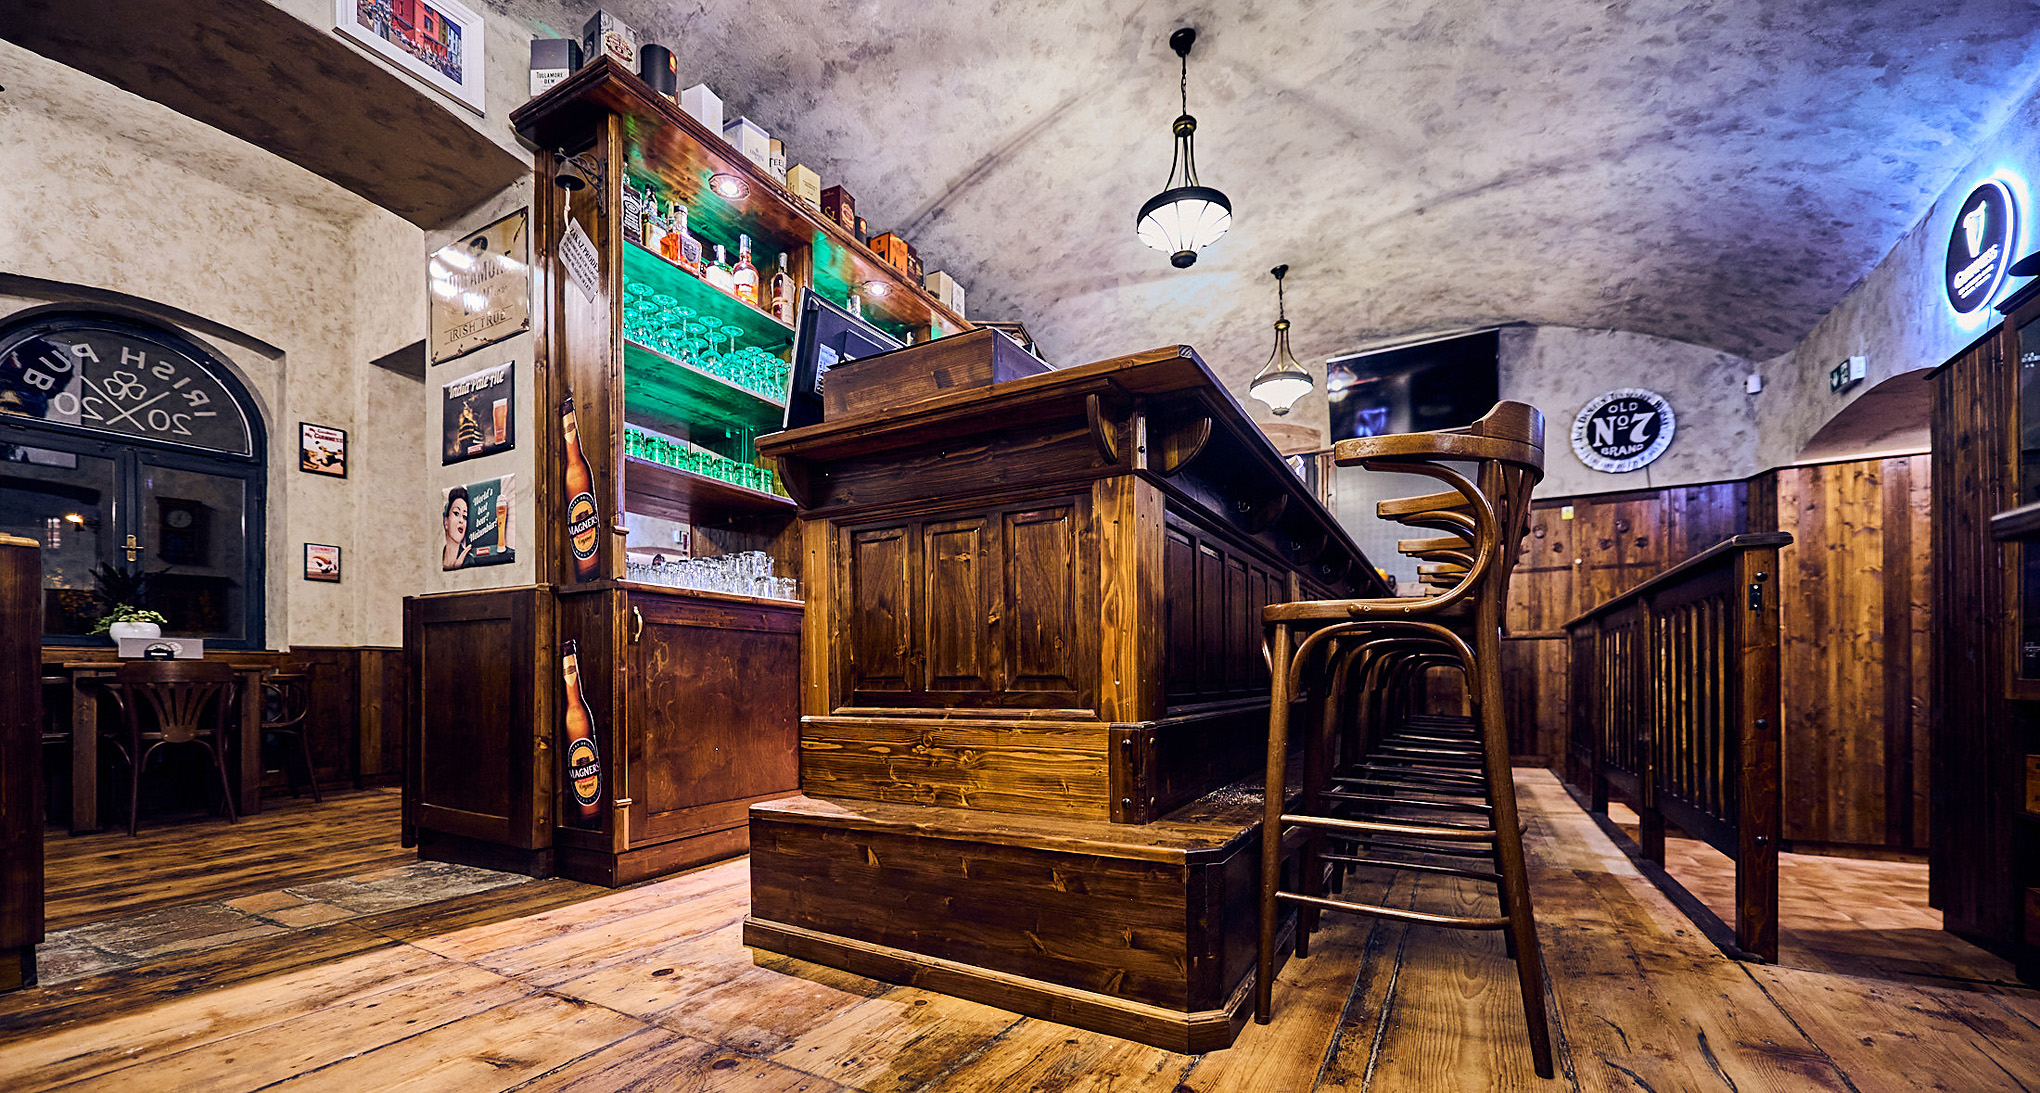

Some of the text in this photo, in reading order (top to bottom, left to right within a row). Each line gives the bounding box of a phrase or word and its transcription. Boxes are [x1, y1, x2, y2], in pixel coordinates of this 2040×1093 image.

[450, 310, 506, 342] IRISH TRUE
[449, 382, 470, 399] India
[1608, 402, 1638, 413] OLD
[1601, 443, 1644, 457] BRAND
